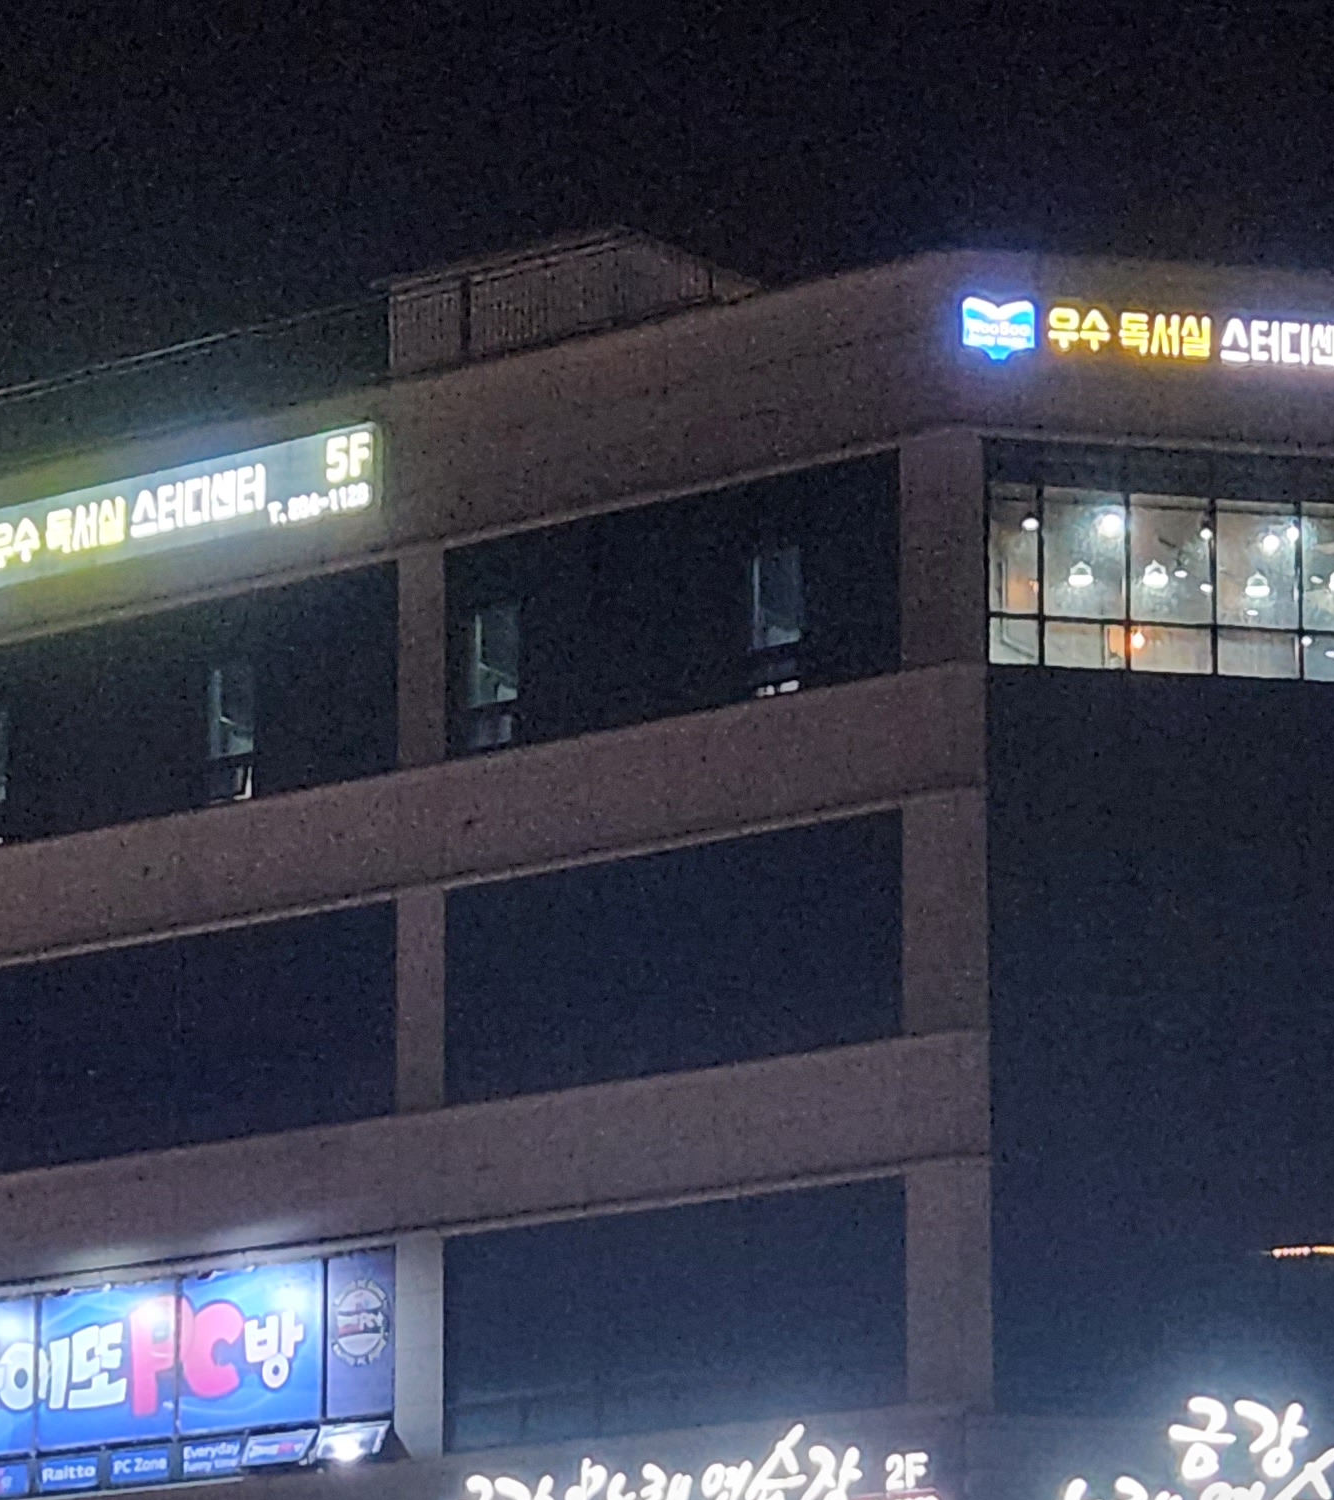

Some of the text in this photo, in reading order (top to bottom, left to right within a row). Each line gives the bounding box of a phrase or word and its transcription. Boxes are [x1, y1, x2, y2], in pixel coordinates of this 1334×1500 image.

[1048, 307, 1110, 352] 우수
[1118, 312, 1211, 360] 독서실
[325, 431, 373, 484] 5F
[45, 495, 126, 555] 독서실
[129, 463, 267, 540] 스터디센터
[42, 1463, 97, 1482] Raitto
[113, 1455, 167, 1474] PC Zone
[886, 1452, 929, 1491] 2F
